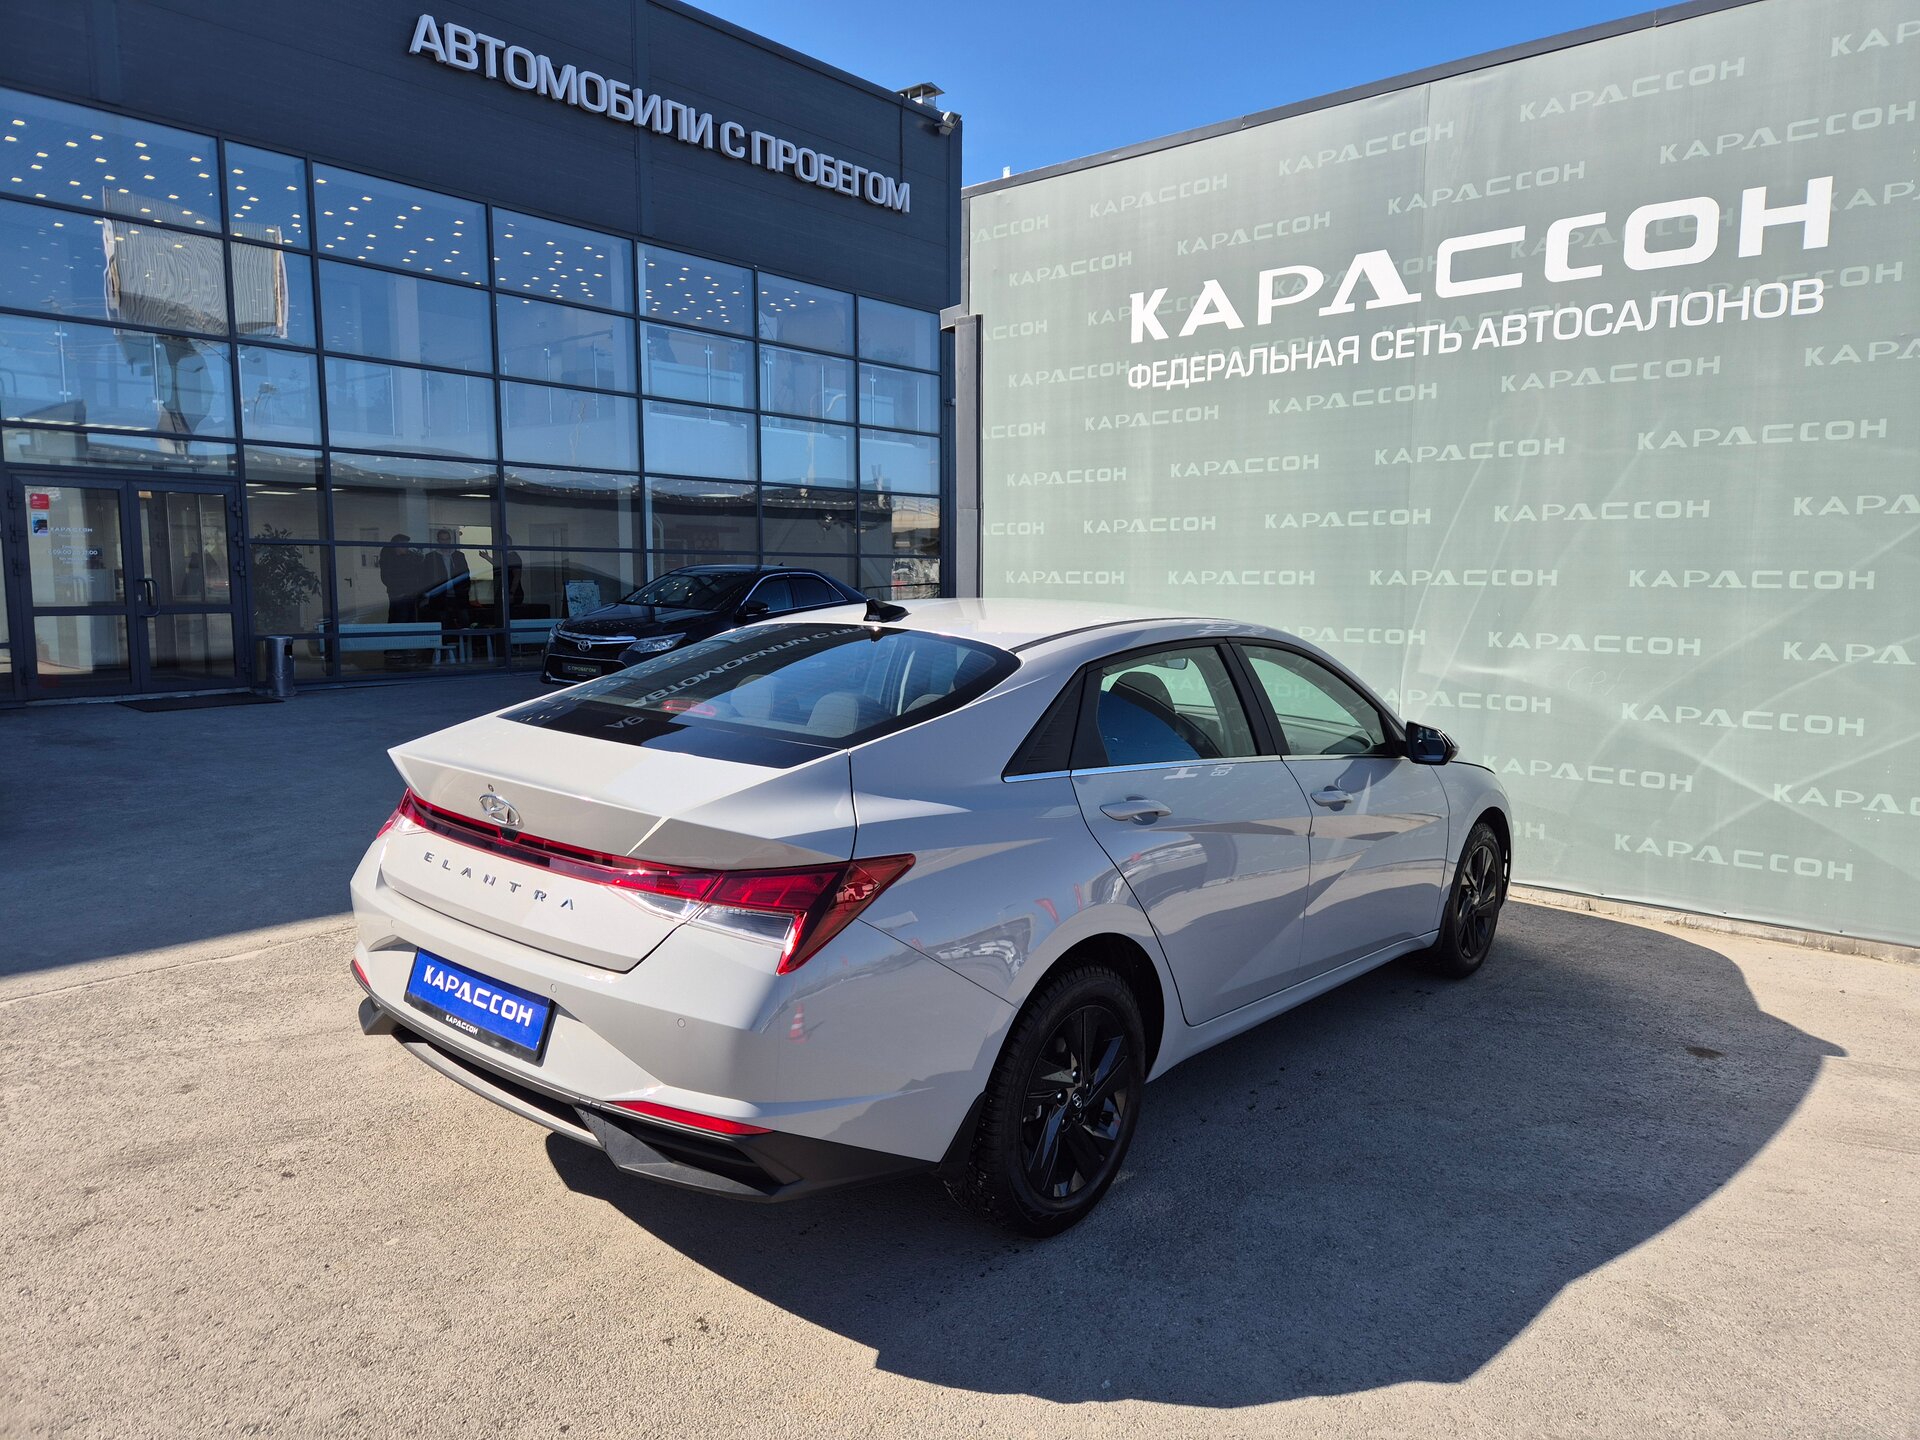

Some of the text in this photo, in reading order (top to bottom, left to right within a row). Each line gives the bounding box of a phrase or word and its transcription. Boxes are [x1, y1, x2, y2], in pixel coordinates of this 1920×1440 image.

[1519, 56, 1746, 123] КАРАССОН
[409, 14, 911, 214] АВТОМОБИЛИ С ПРОБЕГОМ
[1278, 121, 1454, 176] КАРАССОН
[1659, 100, 1916, 164] КАРАССОН
[1089, 174, 1228, 218] КАРАССОН
[1387, 160, 1586, 216] КАРАССОН
[1177, 211, 1331, 256] КАРАССОН
[1008, 250, 1132, 287] КАРАССОН
[1130, 176, 1834, 344] КАРАССОН
[1127, 278, 1824, 391] ФЕДЕРАЛЬНАЯ СЕТЬ АВТОСАЛОНОВ
[1008, 360, 1130, 388] КАРАССОН
[1501, 355, 1721, 393] КАРАССОН
[1268, 383, 1437, 414] КАРАССОН
[1085, 404, 1219, 431] КАРАССОН
[1374, 437, 1565, 465] КАРАССОН
[1637, 418, 1887, 451] КАРАССОН
[1007, 467, 1127, 487] КАРАССОН
[1170, 454, 1320, 478] КАРАССОН
[1083, 516, 1216, 534] КАРАССОН
[1265, 508, 1430, 529] КАРАССОН
[1494, 500, 1710, 522] КАРАССОН
[1005, 570, 1125, 585] КАРАССОН
[1167, 569, 1315, 586] КАРАССОН
[1369, 569, 1558, 587] КАРАССОН
[1628, 569, 1875, 590] КАРАССОН
[1488, 631, 1701, 656] КАРАССОН
[1621, 702, 1864, 738] КАРАССОН
[1615, 833, 1853, 882] КАРАССОН
[423, 851, 574, 910] ELANTRA
[423, 964, 533, 1027] КАРАССОН
[445, 1014, 479, 1035] КАРАССОН
